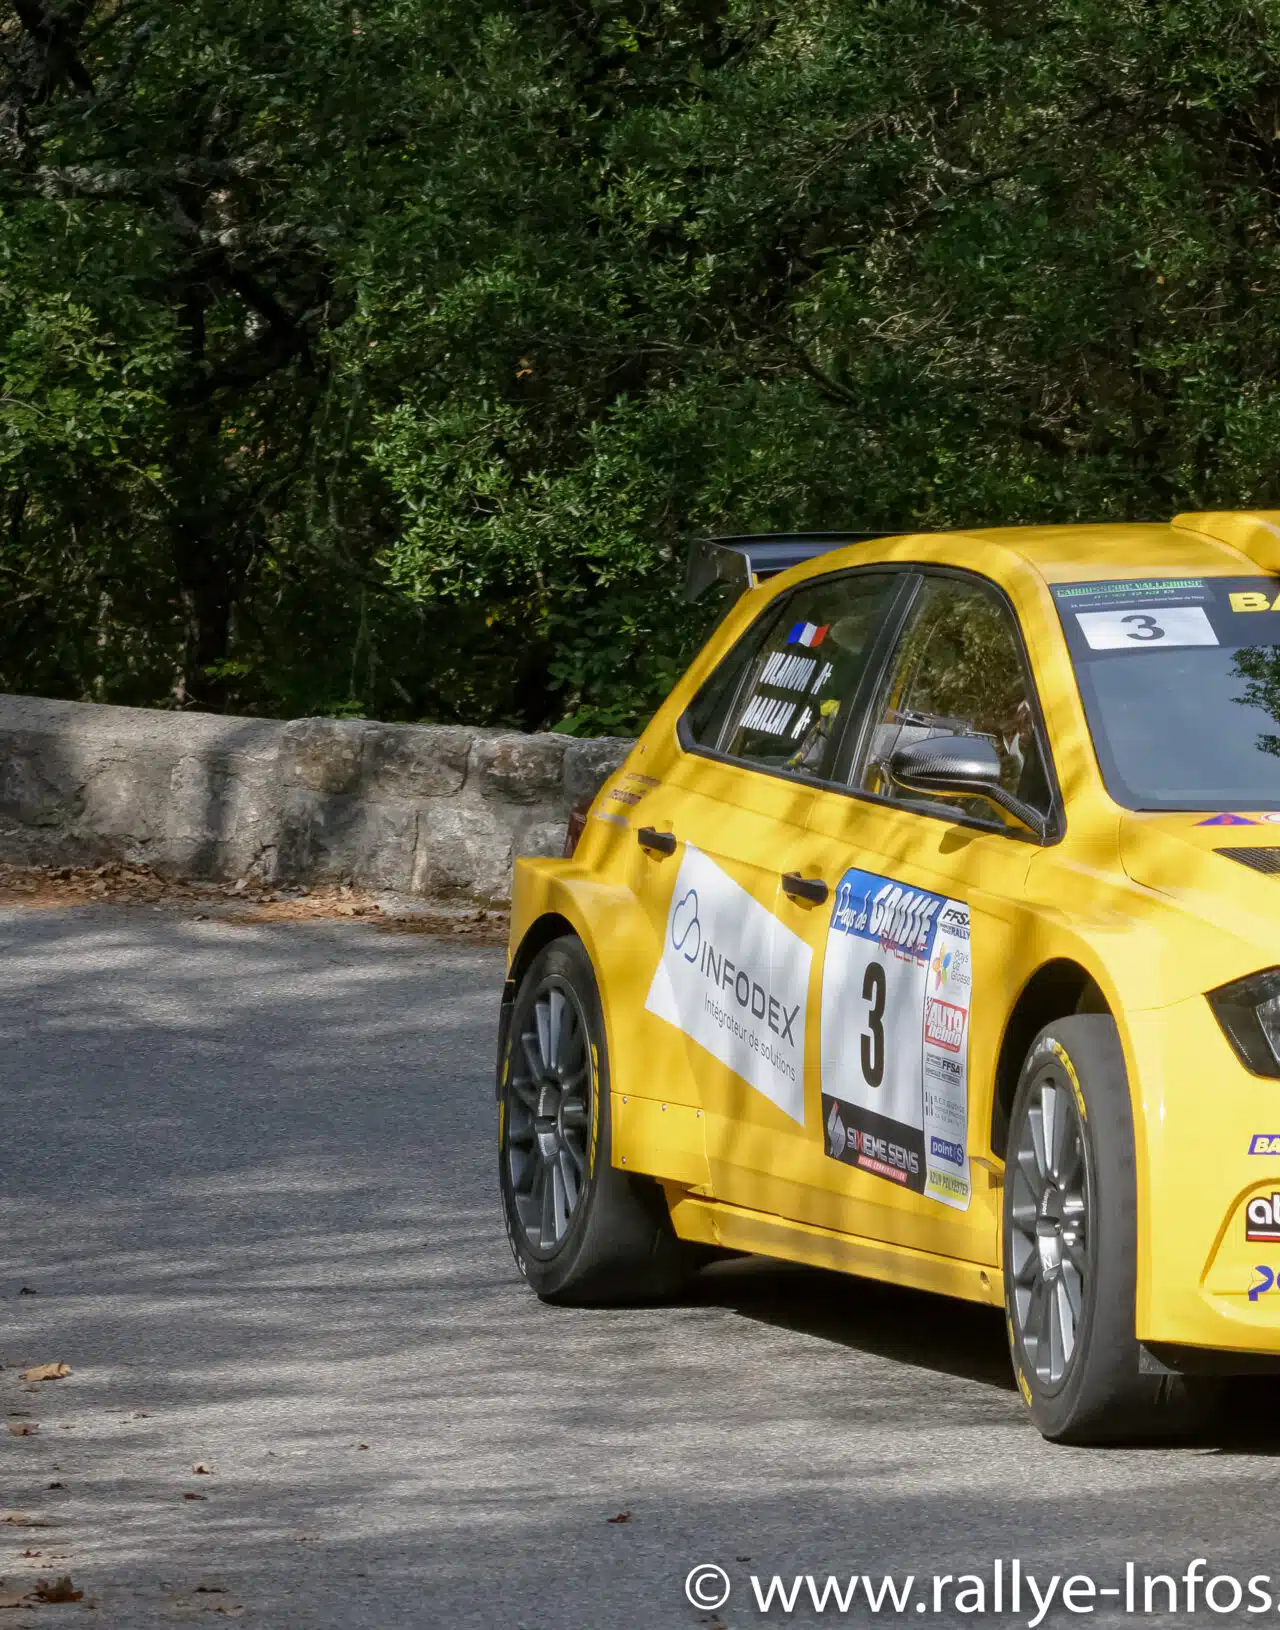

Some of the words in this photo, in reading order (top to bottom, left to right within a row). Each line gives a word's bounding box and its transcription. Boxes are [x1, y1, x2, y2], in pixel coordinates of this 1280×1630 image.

[1121, 614, 1165, 641] 3
[760, 651, 817, 692] VILANOVA
[740, 695, 797, 736] MAILLAN
[832, 882, 855, 936] Pays
[700, 941, 800, 1047] INFODEX
[704, 992, 748, 1042] Intégrateur
[748, 1030, 759, 1052] de
[760, 1043, 796, 1081] solutions
[860, 961, 886, 1088] 3
[927, 1003, 964, 1034] AUTO
[942, 1060, 961, 1075] FFSA
[888, 1142, 919, 1174] SENS
[932, 1140, 953, 1158] point
[956, 1146, 964, 1163] S
[942, 1173, 969, 1197] POLYESTER
